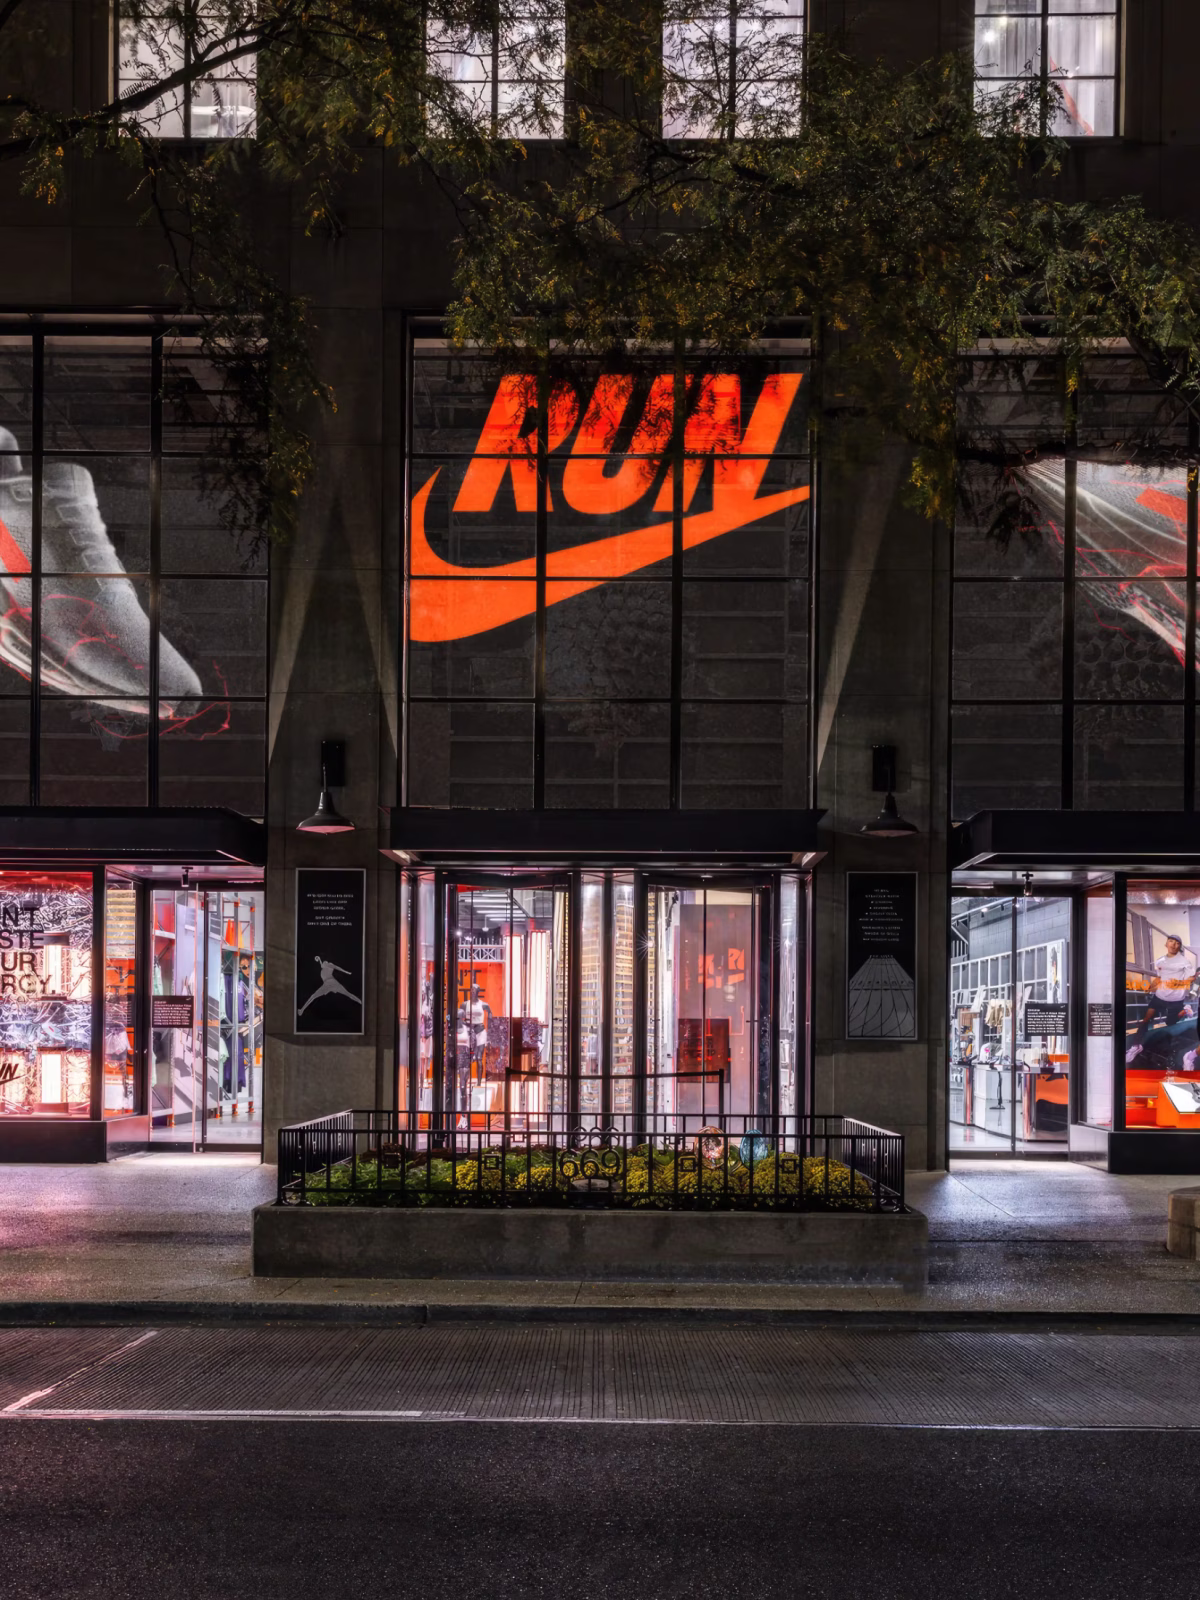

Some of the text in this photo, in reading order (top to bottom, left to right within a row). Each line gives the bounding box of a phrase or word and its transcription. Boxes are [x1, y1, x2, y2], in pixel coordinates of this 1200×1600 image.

[452, 373, 804, 514] RUN
[0, 930, 44, 949] STE
[1, 952, 37, 971] UR
[559, 1149, 621, 1179] 669
